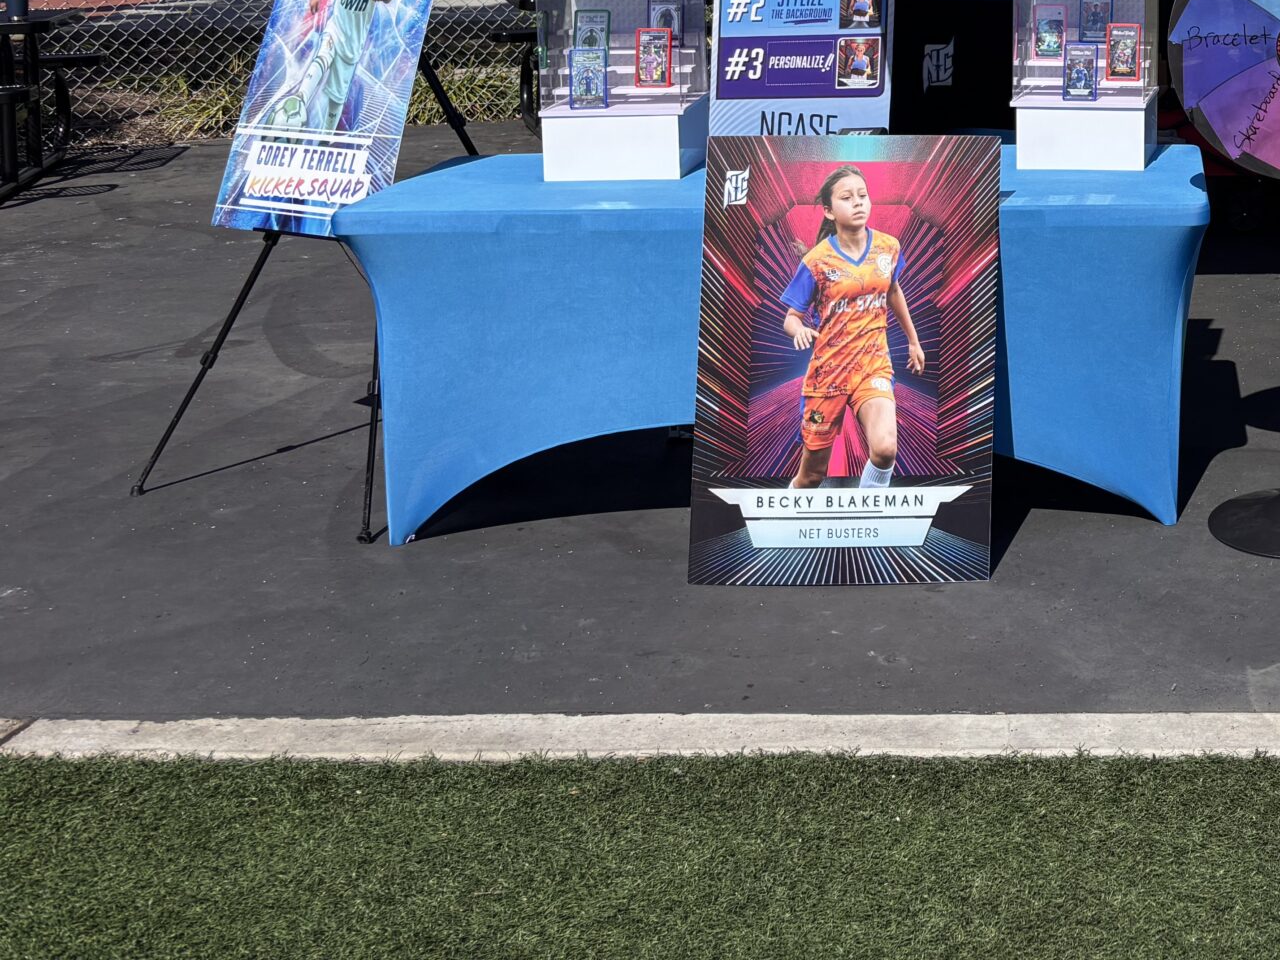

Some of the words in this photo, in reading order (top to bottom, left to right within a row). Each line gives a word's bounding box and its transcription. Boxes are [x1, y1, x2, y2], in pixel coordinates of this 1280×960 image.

[771, 9, 785, 19] THE
[785, 7, 833, 19] BACKGROUND
[1187, 25, 1270, 51] Bracelet
[724, 48, 764, 81] #3
[759, 111, 838, 135] NCASE
[256, 144, 298, 168] COREY
[302, 147, 356, 174] TERRELL
[756, 496, 815, 509] BECKY
[826, 494, 925, 508] BLAKEMAN
[798, 528, 821, 540] NET
[827, 527, 879, 539] BUSTERS
